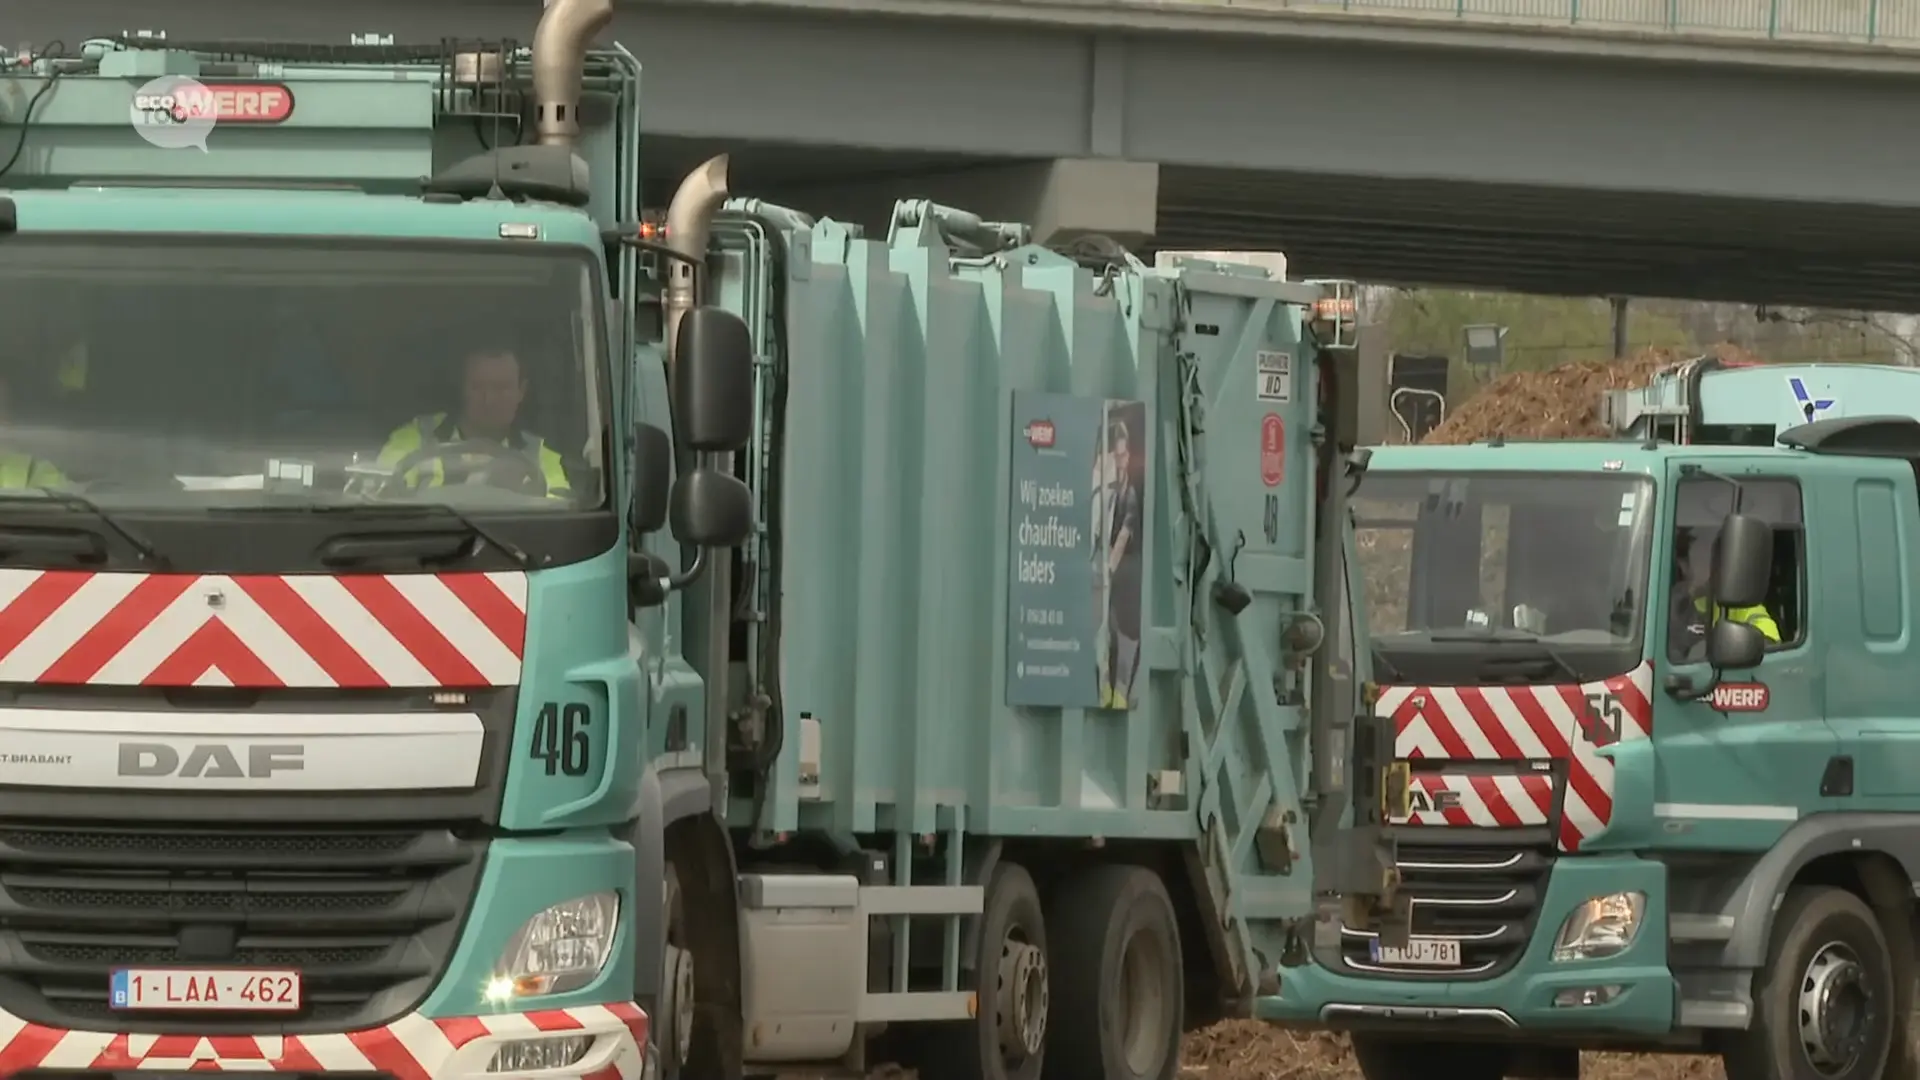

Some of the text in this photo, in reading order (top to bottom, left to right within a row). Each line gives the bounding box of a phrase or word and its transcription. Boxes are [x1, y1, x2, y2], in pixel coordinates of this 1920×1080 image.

[1020, 479, 1074, 511] Wij zoeken
[1018, 550, 1056, 584] laders
[1714, 688, 1765, 706] WERF
[1583, 693, 1622, 742] 55
[530, 702, 591, 777] 46
[118, 743, 304, 778] DAF
[1408, 790, 1461, 812] AF
[132, 976, 293, 1003] 1-LAA-462
